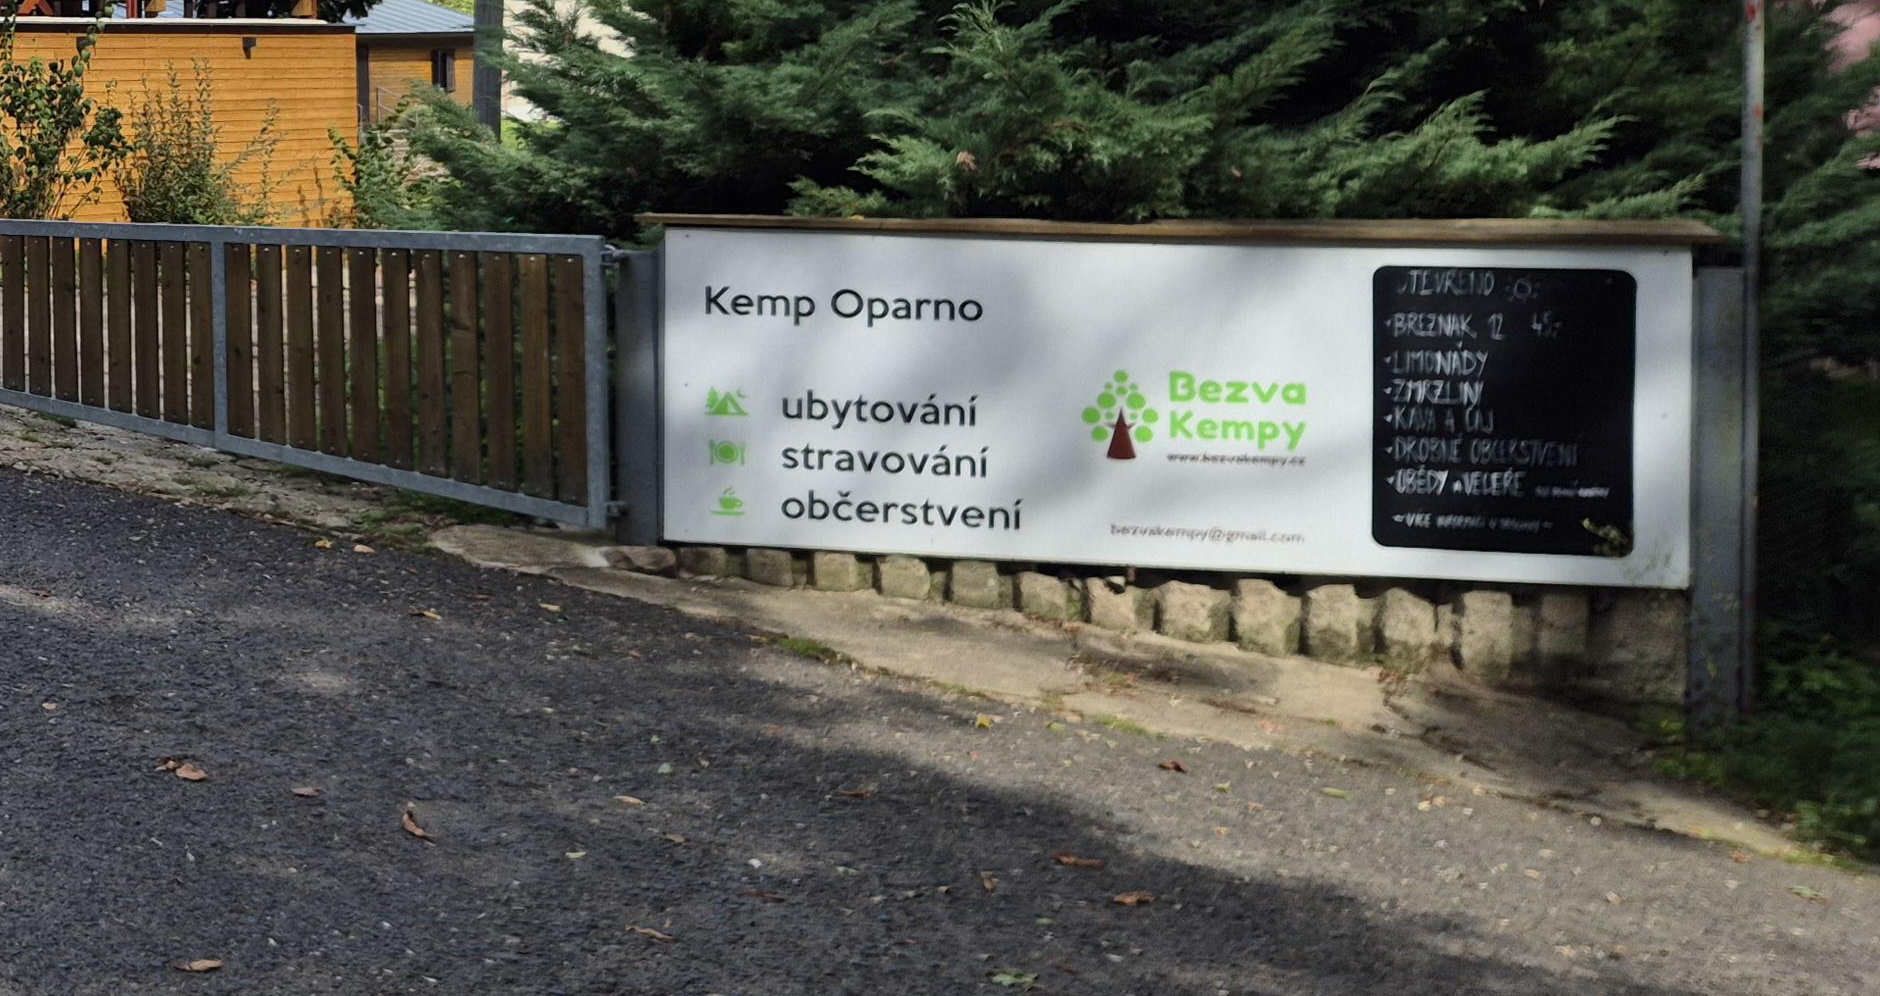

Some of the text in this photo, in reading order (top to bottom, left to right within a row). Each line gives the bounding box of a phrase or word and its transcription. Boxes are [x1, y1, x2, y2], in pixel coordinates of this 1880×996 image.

[705, 285, 984, 328] Kemp Oparno
[1488, 312, 1506, 341] 12
[1169, 370, 1307, 404] Bezva
[782, 390, 979, 430] ubytování
[1169, 410, 1307, 451] Kempy
[781, 443, 990, 478] stravování
[781, 490, 1024, 530] občerstvení
